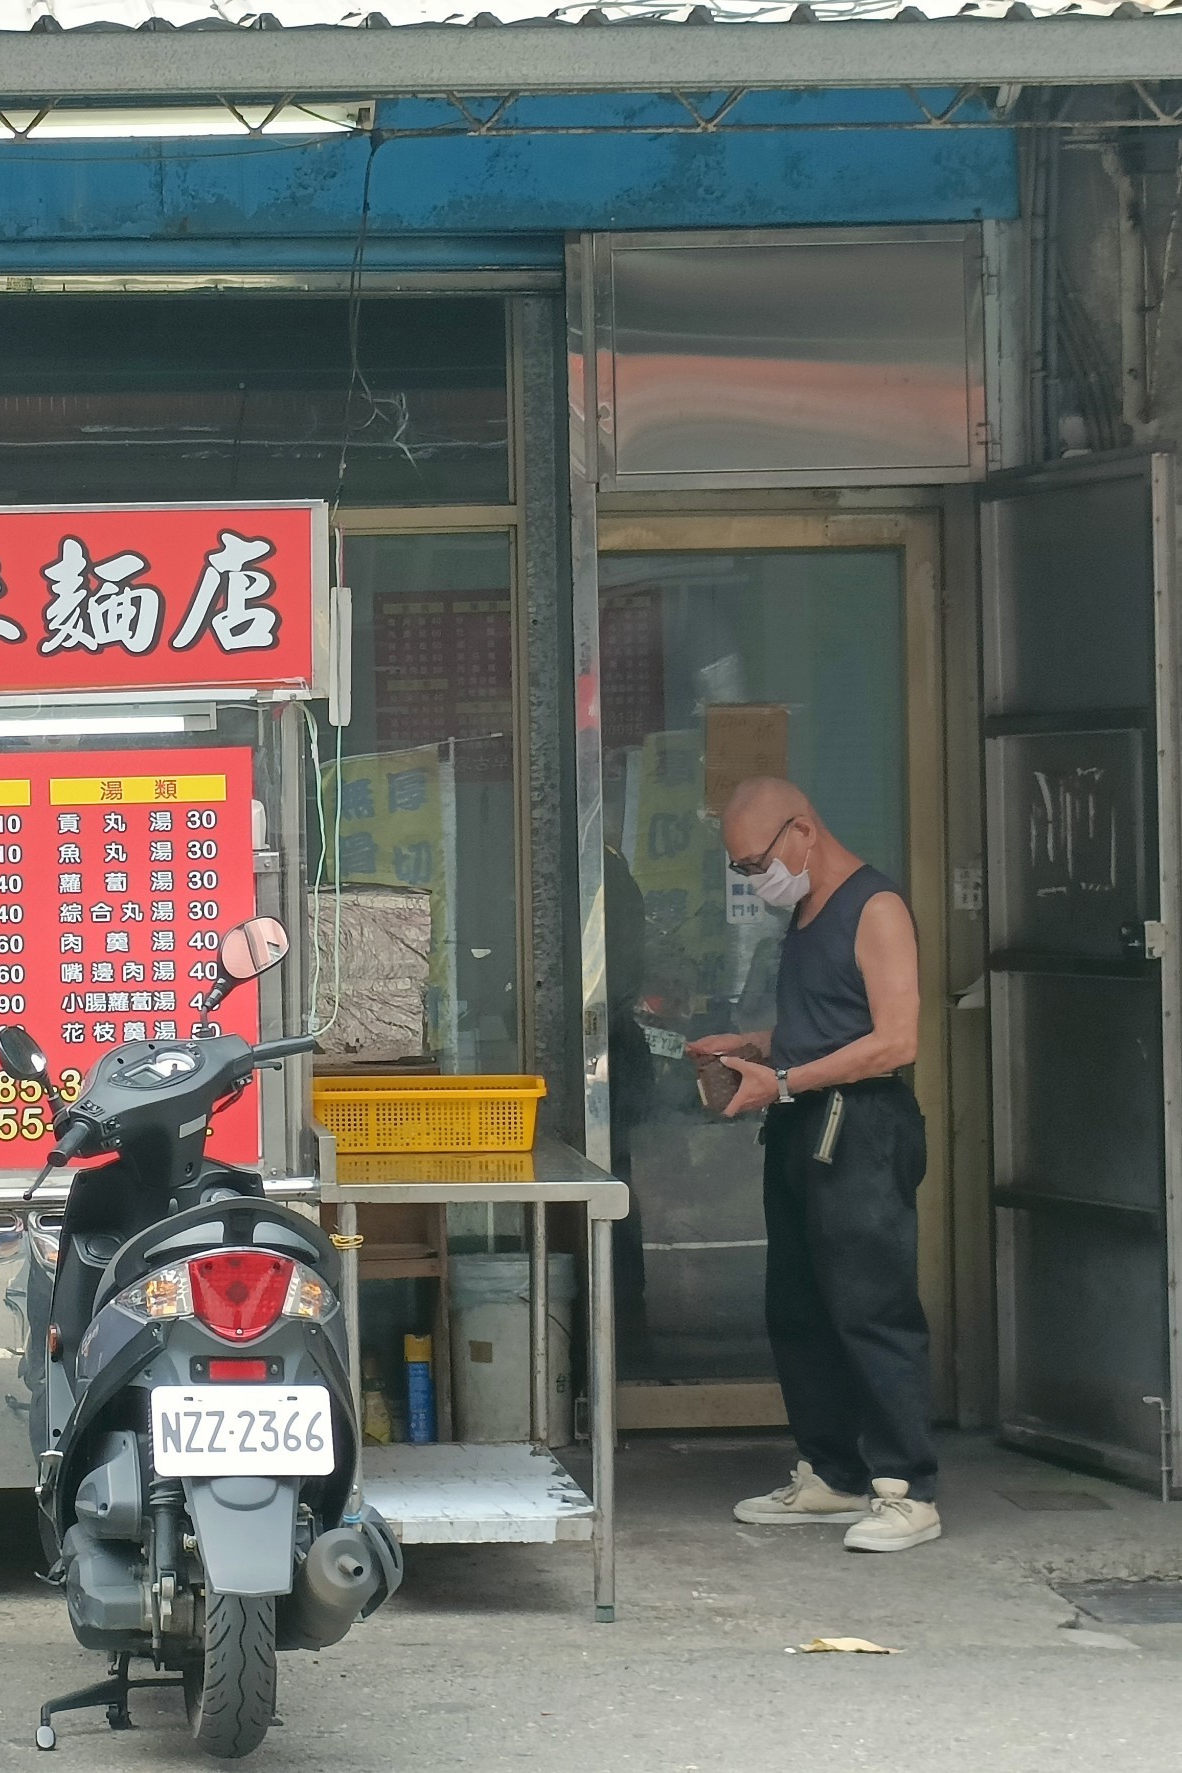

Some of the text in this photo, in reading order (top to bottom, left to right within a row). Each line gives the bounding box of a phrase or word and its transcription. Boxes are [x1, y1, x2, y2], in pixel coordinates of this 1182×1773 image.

[100, 780, 177, 800] 湯類
[58, 811, 216, 833] 貢丸湯 30
[58, 841, 216, 863] 魚丸湯 30
[60, 871, 217, 893] 蘿蔔湯 30
[60, 902, 218, 923] 綜合丸湯 30
[61, 932, 218, 954] 肉羹湯 40
[61, 961, 218, 983] 嘴邊肉湯 40
[62, 991, 175, 1013] 小腸蘿蔔湯
[63, 1021, 177, 1043] 花枝羹湯
[161, 1409, 324, 1454] NZZ-2366
